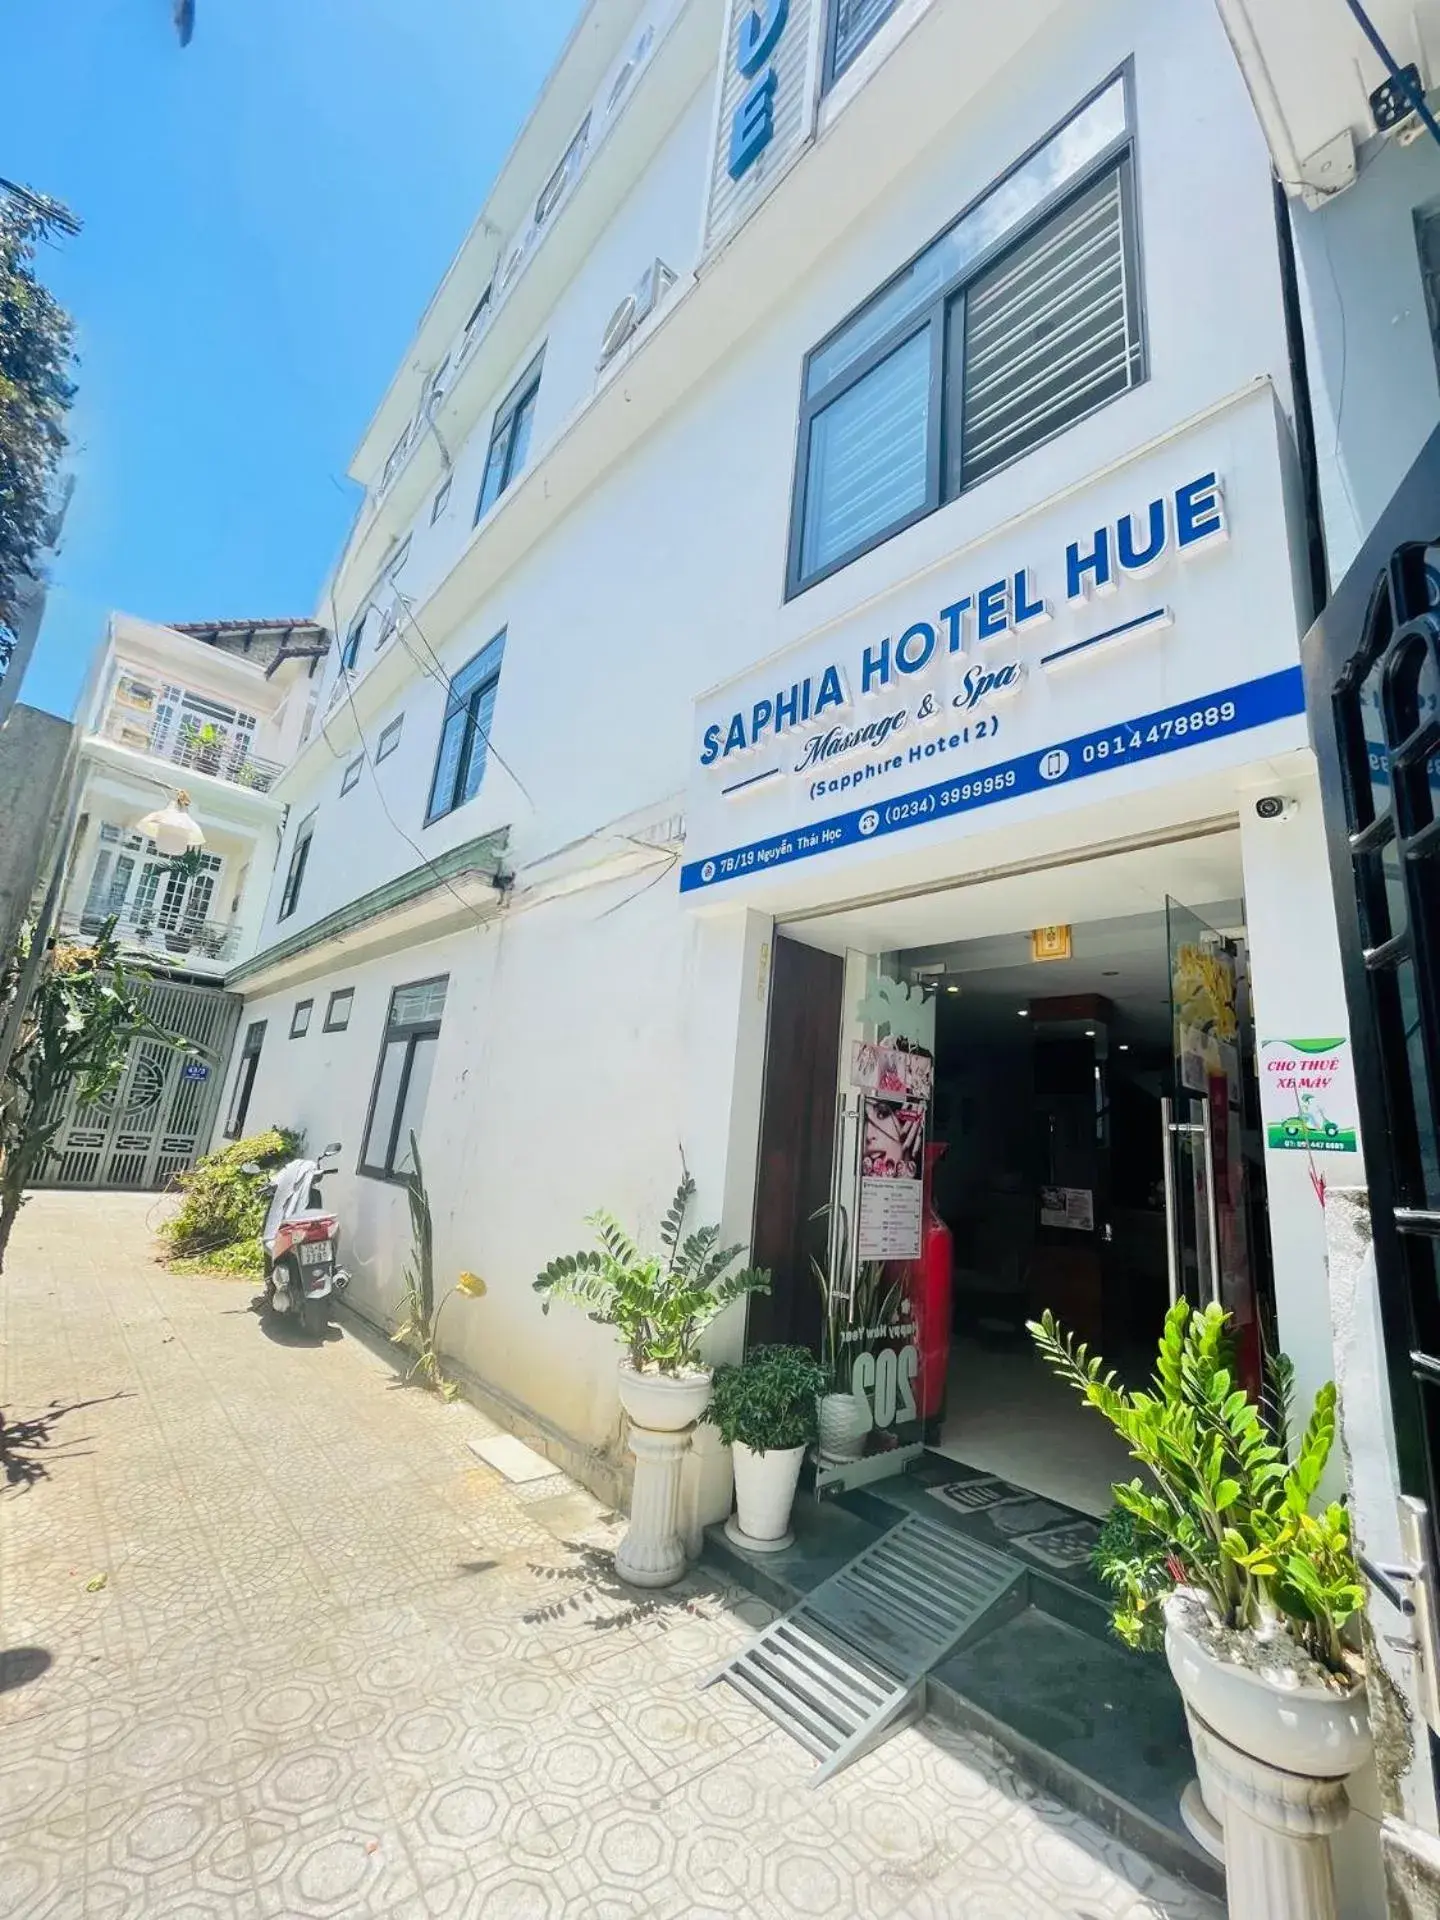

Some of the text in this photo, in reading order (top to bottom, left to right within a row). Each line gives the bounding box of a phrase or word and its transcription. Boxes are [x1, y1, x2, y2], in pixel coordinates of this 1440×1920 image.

[699, 470, 1223, 766] SAPHIA HOTEL HUE
[794, 663, 1019, 772] Massage & Spa
[809, 714, 999, 800] (Sapphire Hotel 2)
[720, 701, 1236, 873] 7B/19 Nguyễn Thái Học (0234) 3999959 0914478889
[1267, 1060, 1297, 1072] CHO
